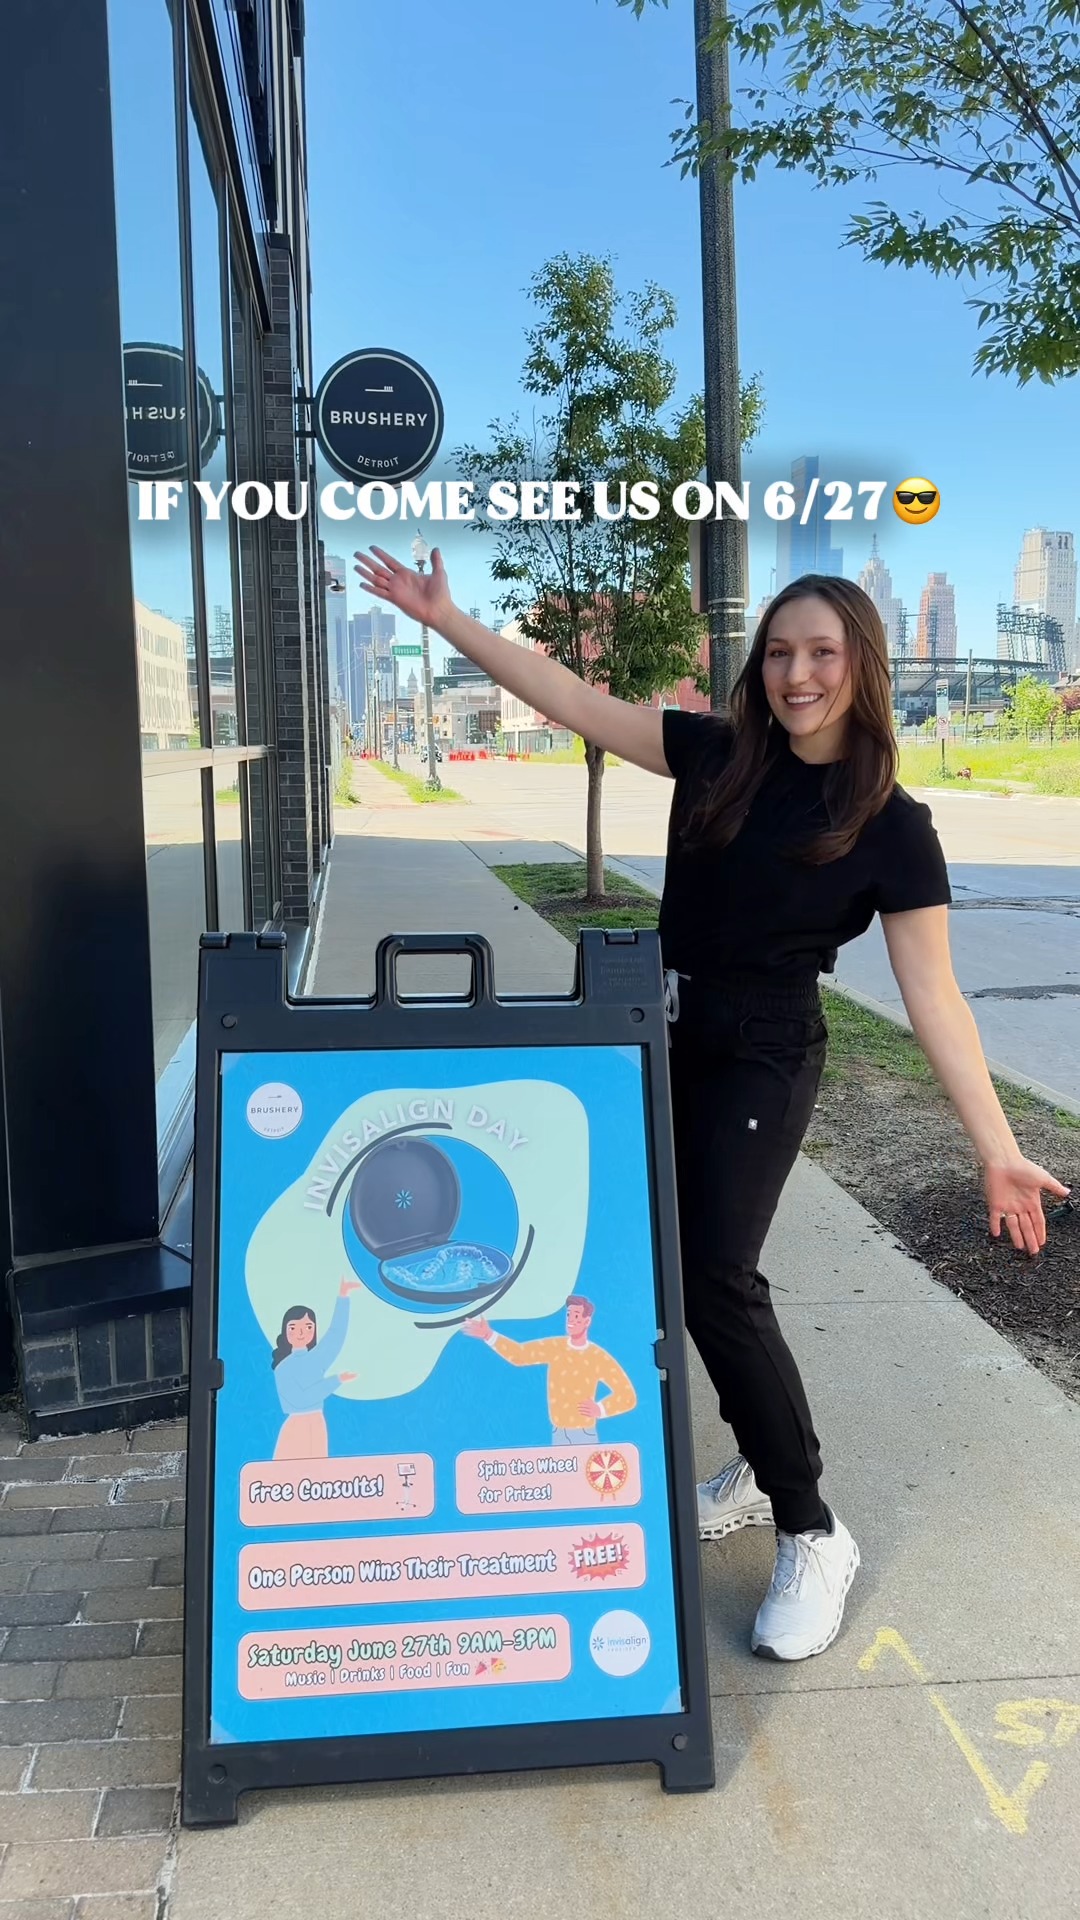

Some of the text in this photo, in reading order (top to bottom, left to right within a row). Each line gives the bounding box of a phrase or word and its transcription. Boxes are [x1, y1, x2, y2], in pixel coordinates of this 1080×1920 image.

[330, 410, 428, 427] BRUSHERY
[357, 455, 399, 468] DETROIT
[250, 1106, 299, 1114] BRUSHERY
[304, 1098, 529, 1211] INVISALIGN DAY
[478, 1456, 578, 1481] Spin the Wheel
[249, 1474, 384, 1503] Free Consults!
[478, 1484, 552, 1503] for Prizes!
[573, 1542, 623, 1569] FREE!
[248, 1549, 557, 1589] One Person Wins Their Treatment
[248, 1627, 556, 1669] Saturday June 27th 9AM-3PM
[607, 1635, 647, 1647] invisalign
[285, 1670, 326, 1687] Music
[339, 1665, 385, 1683] Drinks
[399, 1662, 431, 1679] Food
[445, 1661, 470, 1676] Fun
